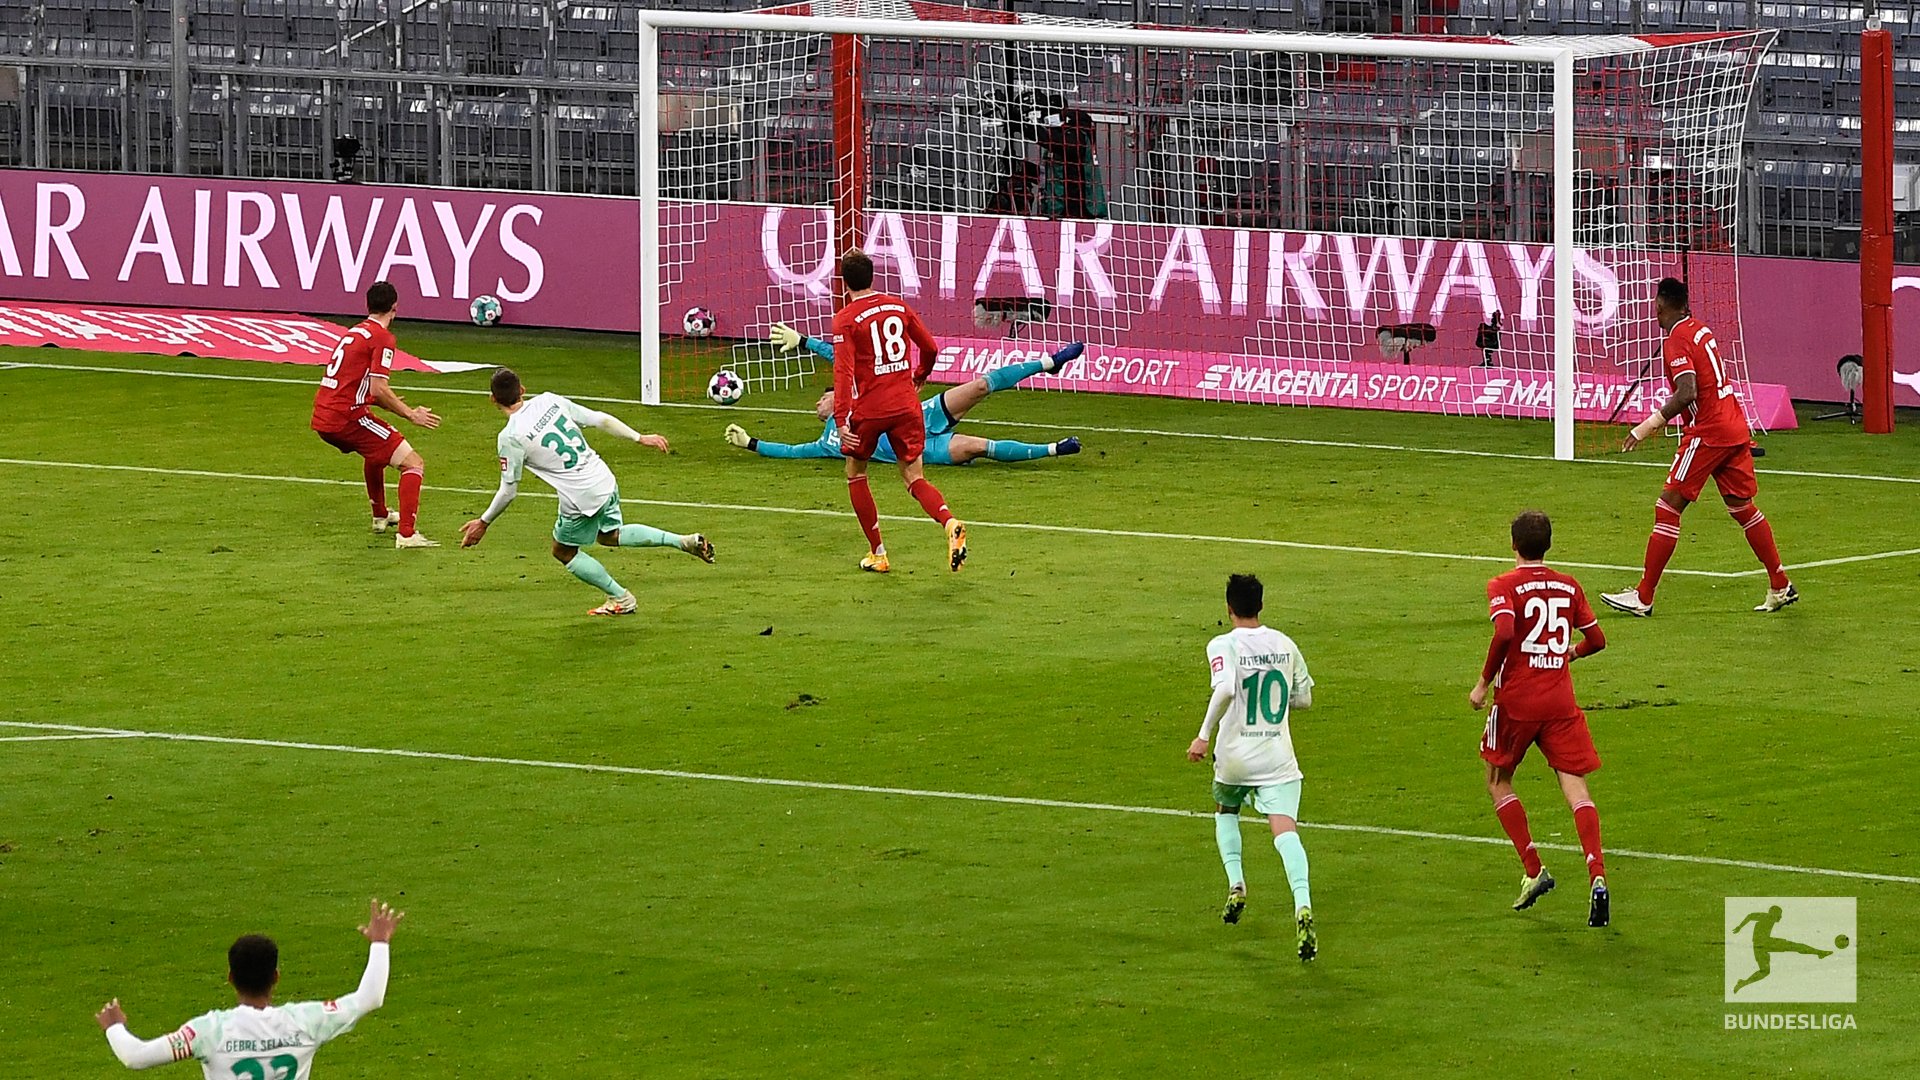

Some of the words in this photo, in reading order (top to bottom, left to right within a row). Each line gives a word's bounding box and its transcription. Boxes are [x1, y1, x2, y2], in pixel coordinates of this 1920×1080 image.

[117, 185, 545, 302] AIRWAYS
[1148, 226, 1620, 335] AIRWAYS
[327, 336, 355, 377] 5
[870, 316, 906, 366] 18
[1090, 354, 1180, 387] SPORT
[1228, 366, 1359, 399] MAGENTA
[1364, 374, 1458, 402] SPORT
[1508, 379, 1645, 412] MAENTA
[541, 414, 587, 470] 35
[1521, 596, 1571, 655] 25
[1529, 653, 1564, 669] MÜLLER
[1242, 669, 1289, 726] 10
[225, 1039, 258, 1053] GEBRE
